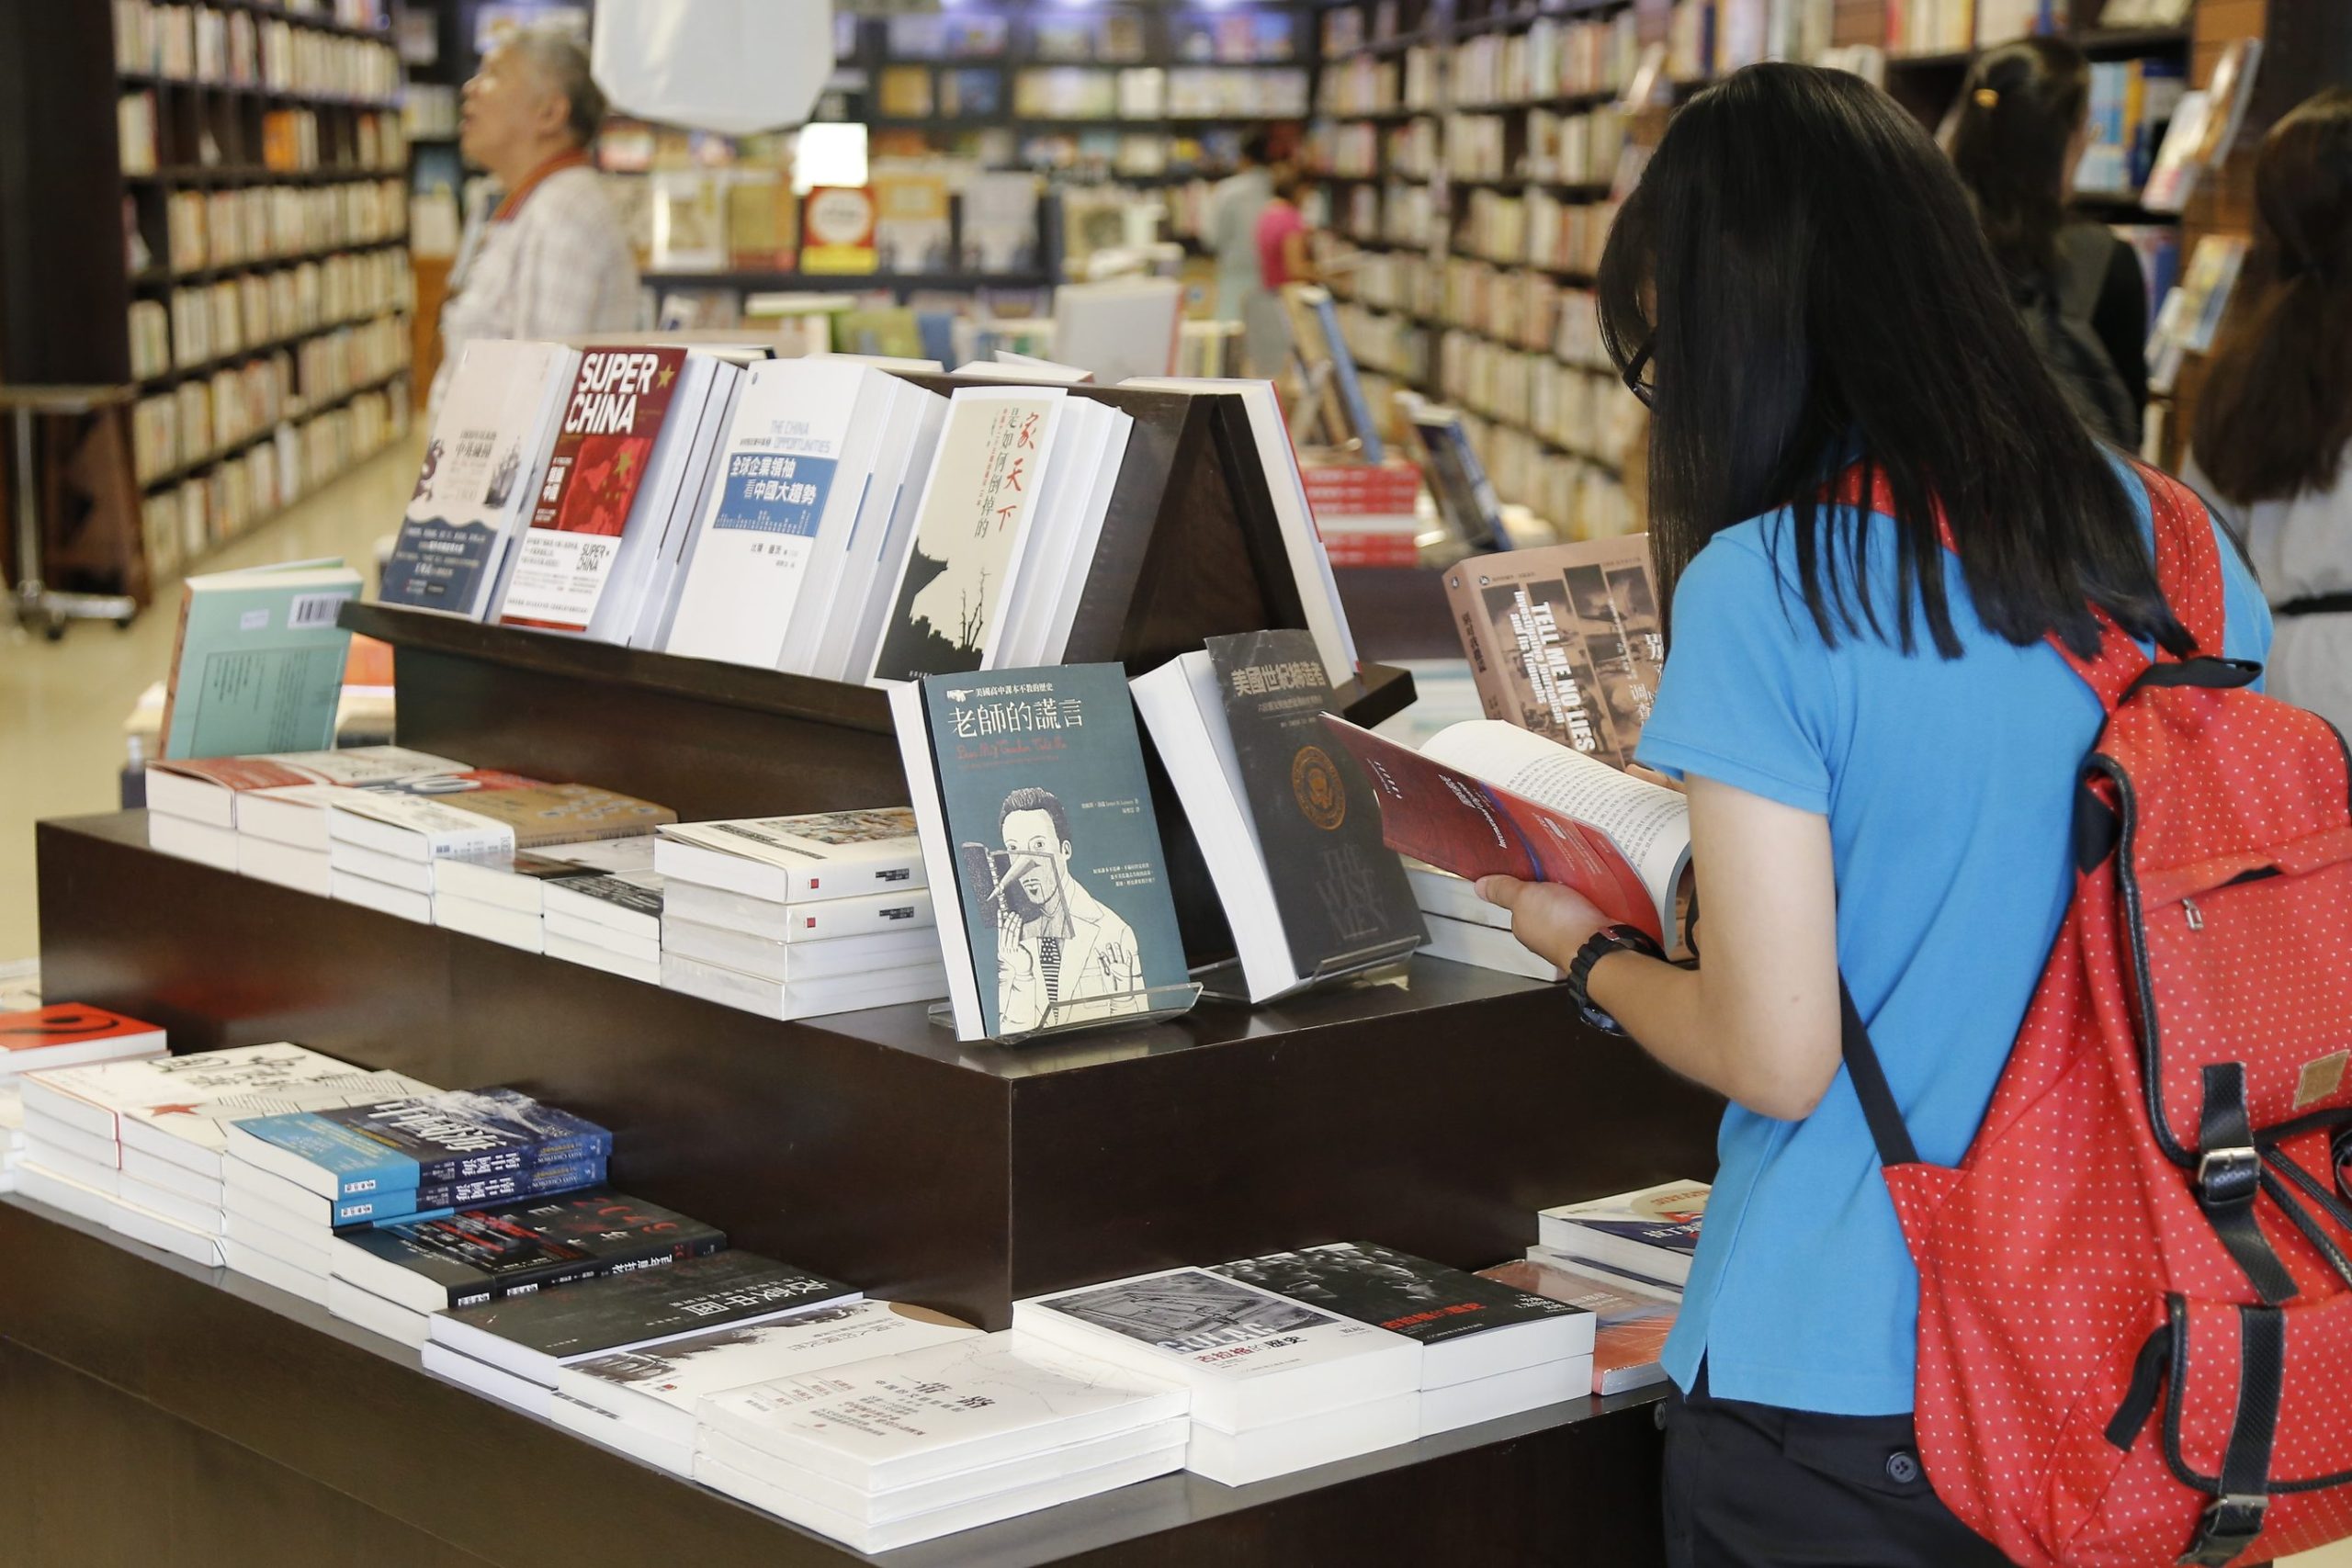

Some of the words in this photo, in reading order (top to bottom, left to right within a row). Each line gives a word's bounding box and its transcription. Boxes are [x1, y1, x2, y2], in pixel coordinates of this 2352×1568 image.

[578, 353, 659, 395] SUPER
[565, 392, 639, 434] CHINA
[730, 457, 796, 479] 全球企業領袖
[975, 407, 1019, 538] 是如何倒掉的
[997, 412, 1039, 532] 家天下
[744, 479, 817, 505] 看中國大趨勢
[576, 557, 597, 571] CHINA
[582, 543, 606, 558] SUPER
[1531, 602, 1560, 644] TELL
[1510, 613, 1524, 634] and
[1522, 652, 1547, 704] Triumphs
[1514, 592, 1545, 663] Investigative
[1538, 663, 1565, 724] Journalism
[1544, 647, 1572, 676] ME
[1555, 679, 1581, 706] NO
[947, 698, 1083, 739] 老師的謊言
[1566, 709, 1596, 751] LIES
[1156, 1323, 1280, 1355] GULAG
[1194, 1336, 1307, 1363] 古拉格的歷史
